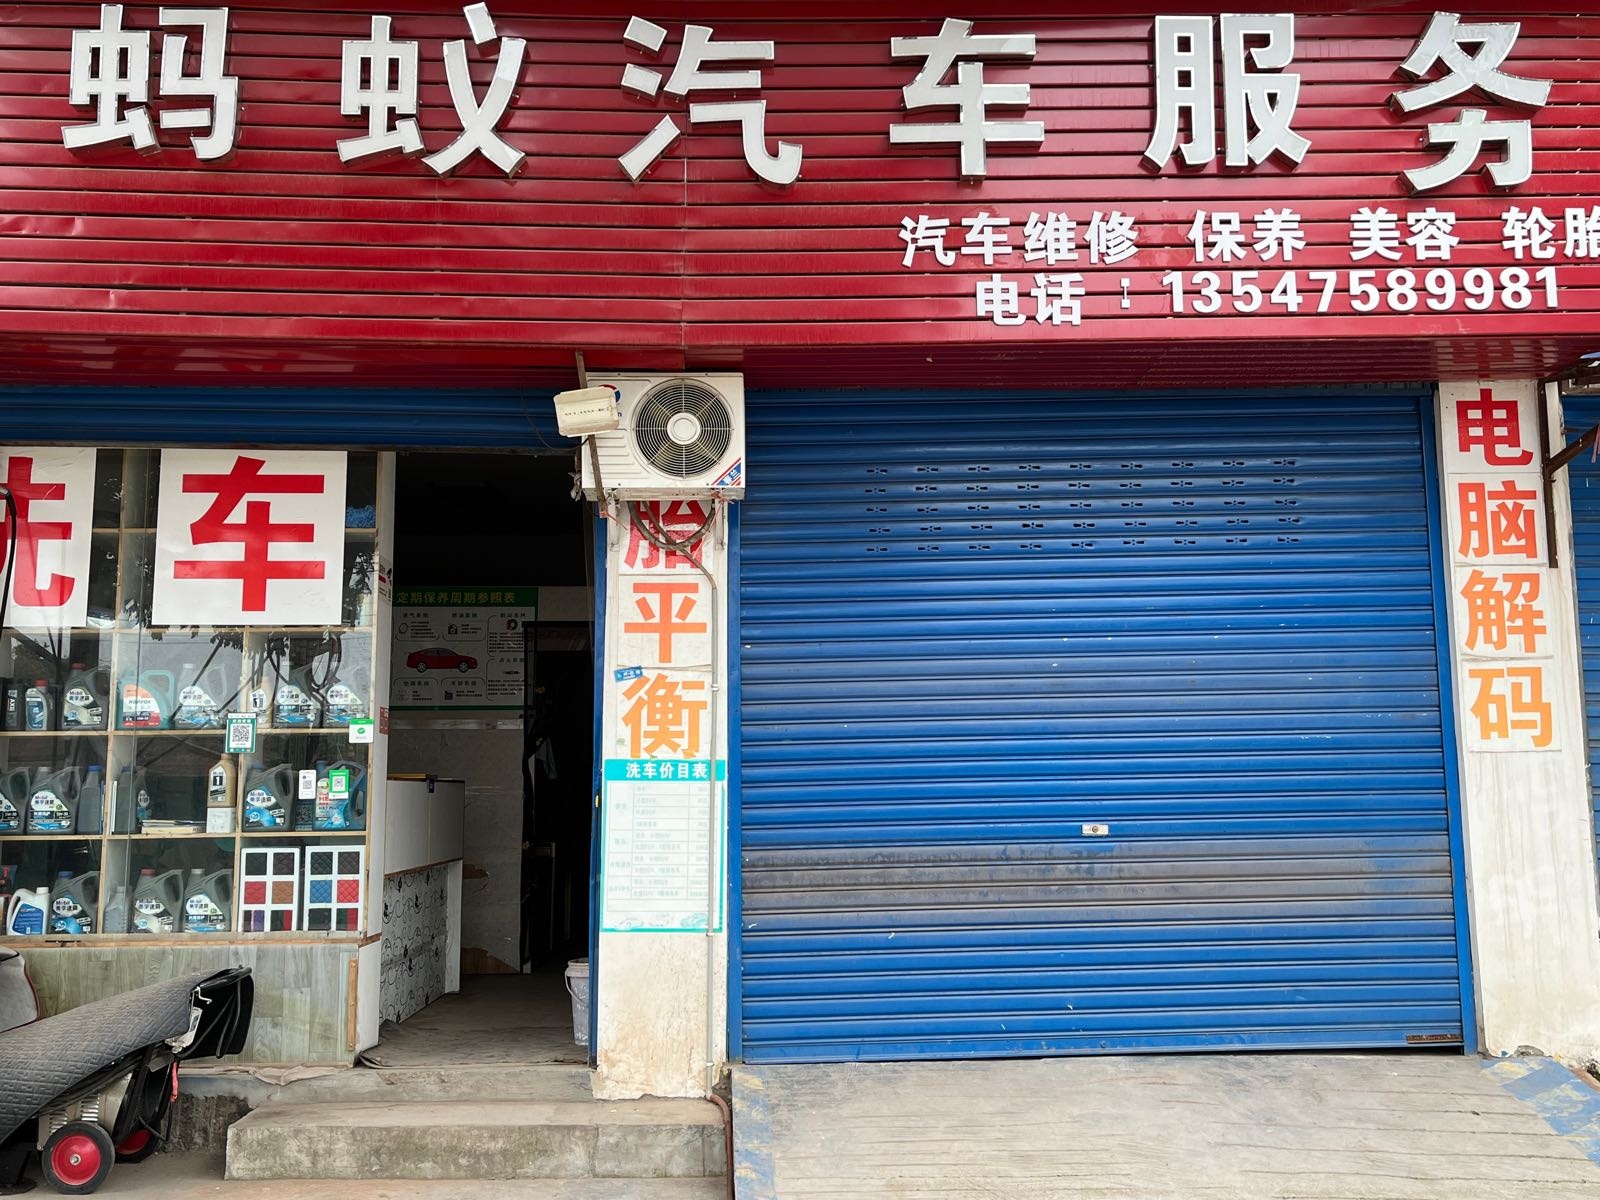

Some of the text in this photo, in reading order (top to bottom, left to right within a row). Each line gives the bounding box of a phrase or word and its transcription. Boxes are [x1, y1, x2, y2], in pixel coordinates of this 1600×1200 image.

[62, 2, 1552, 194] 蚂蚁汽车服务
[899, 210, 1140, 268] 汽车维修
[1186, 208, 1306, 263] 保养
[1349, 207, 1460, 262] 美容
[396, 592, 516, 604] 定期保养周期参照表
[1456, 388, 1554, 748] 电脑解码
[625, 762, 708, 779] 洗车价目表
